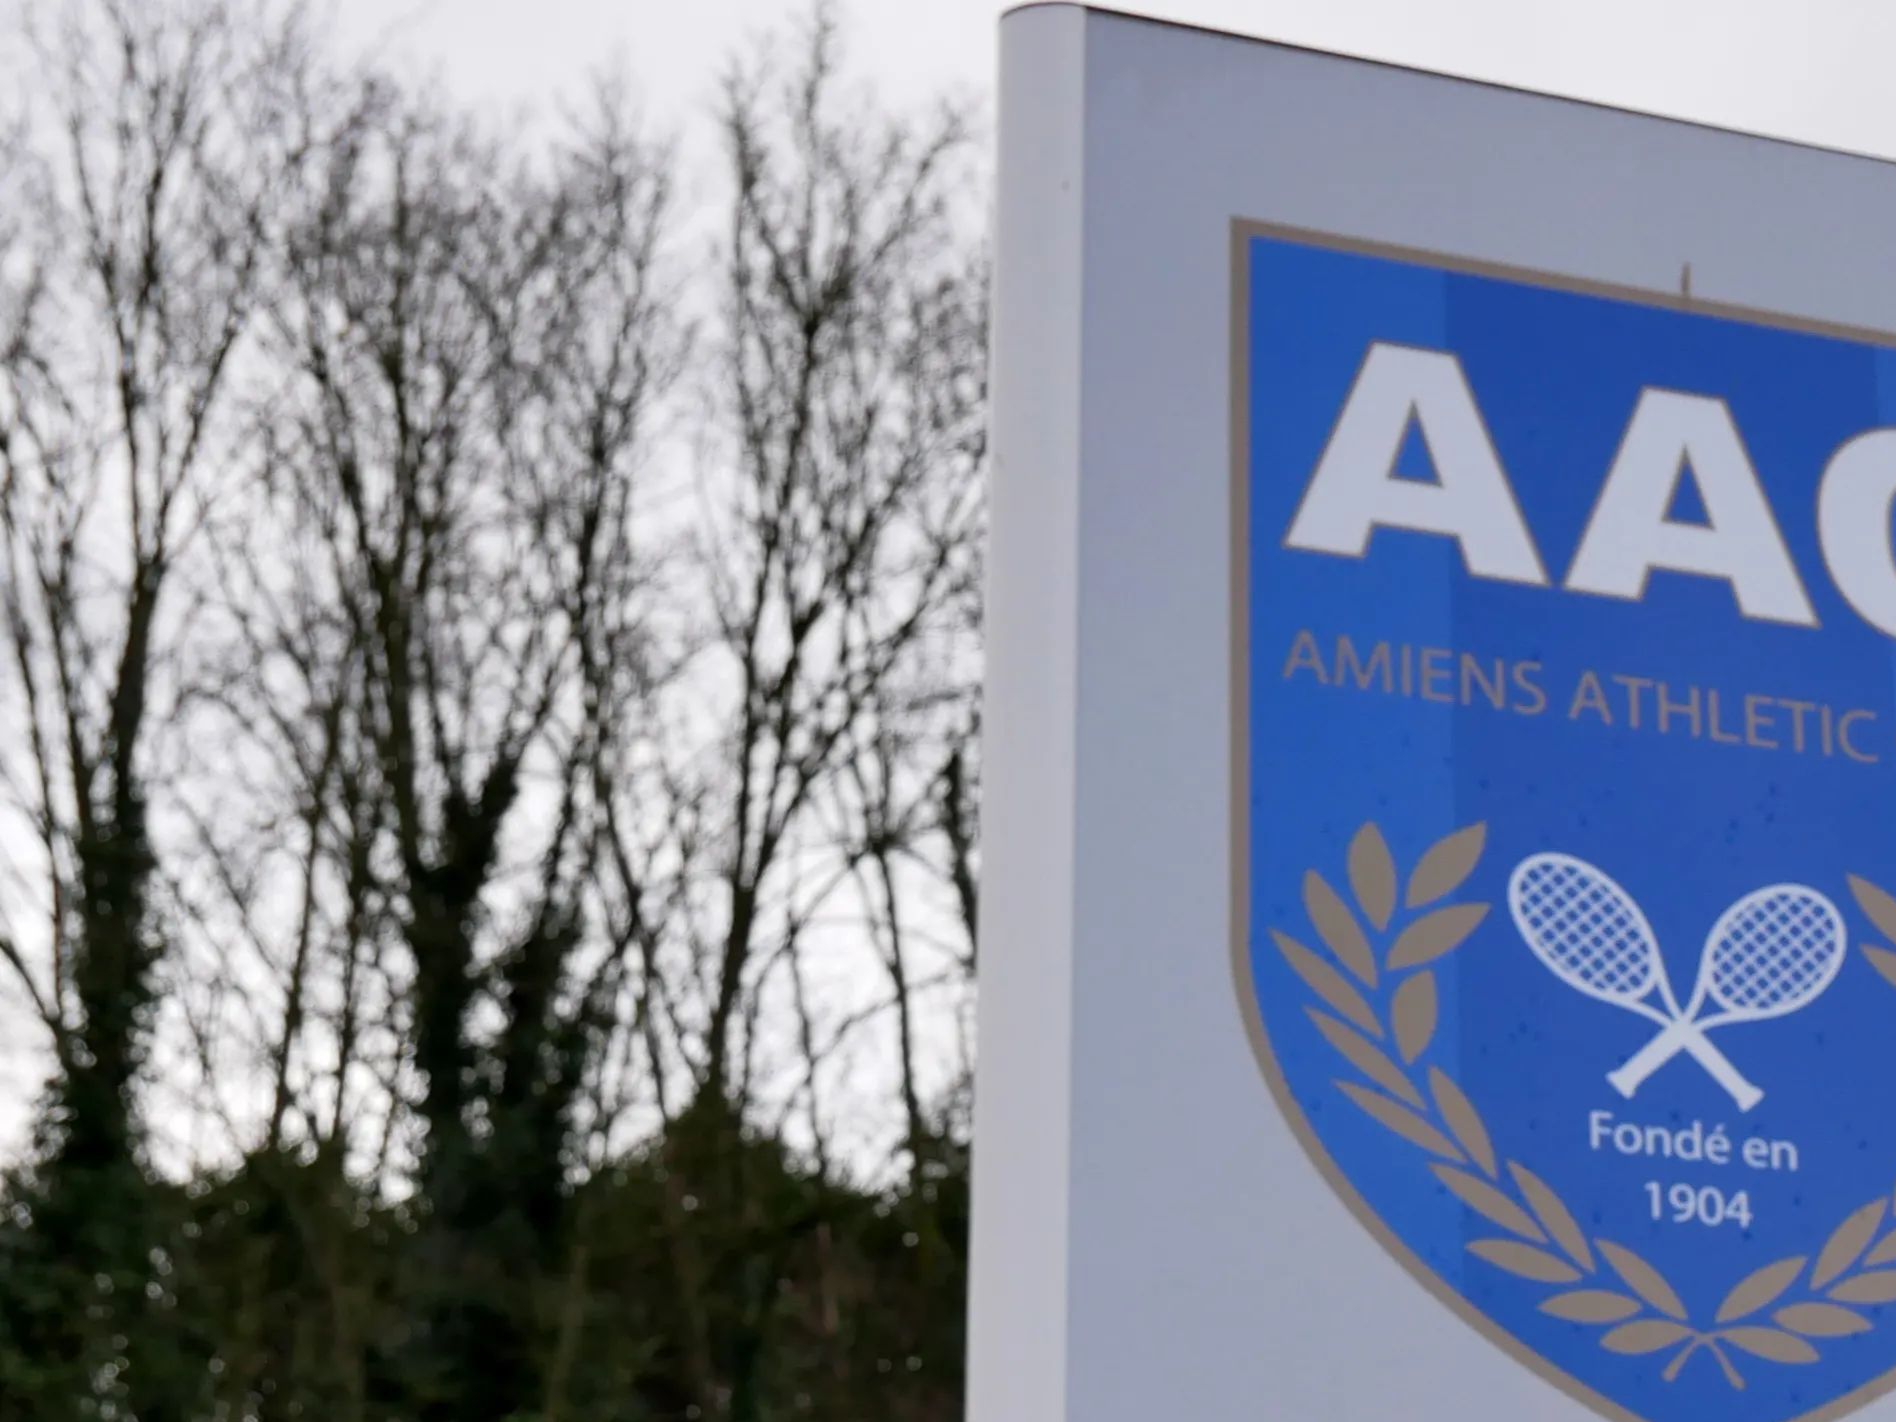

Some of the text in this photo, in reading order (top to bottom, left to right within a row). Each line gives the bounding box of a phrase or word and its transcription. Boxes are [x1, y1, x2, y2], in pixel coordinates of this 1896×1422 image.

[1282, 629, 1548, 717] AMIENS
[1568, 671, 1879, 763] ATHLETIC
[1588, 1110, 1798, 1171] Fondé en
[1644, 1180, 1752, 1229] 1904
